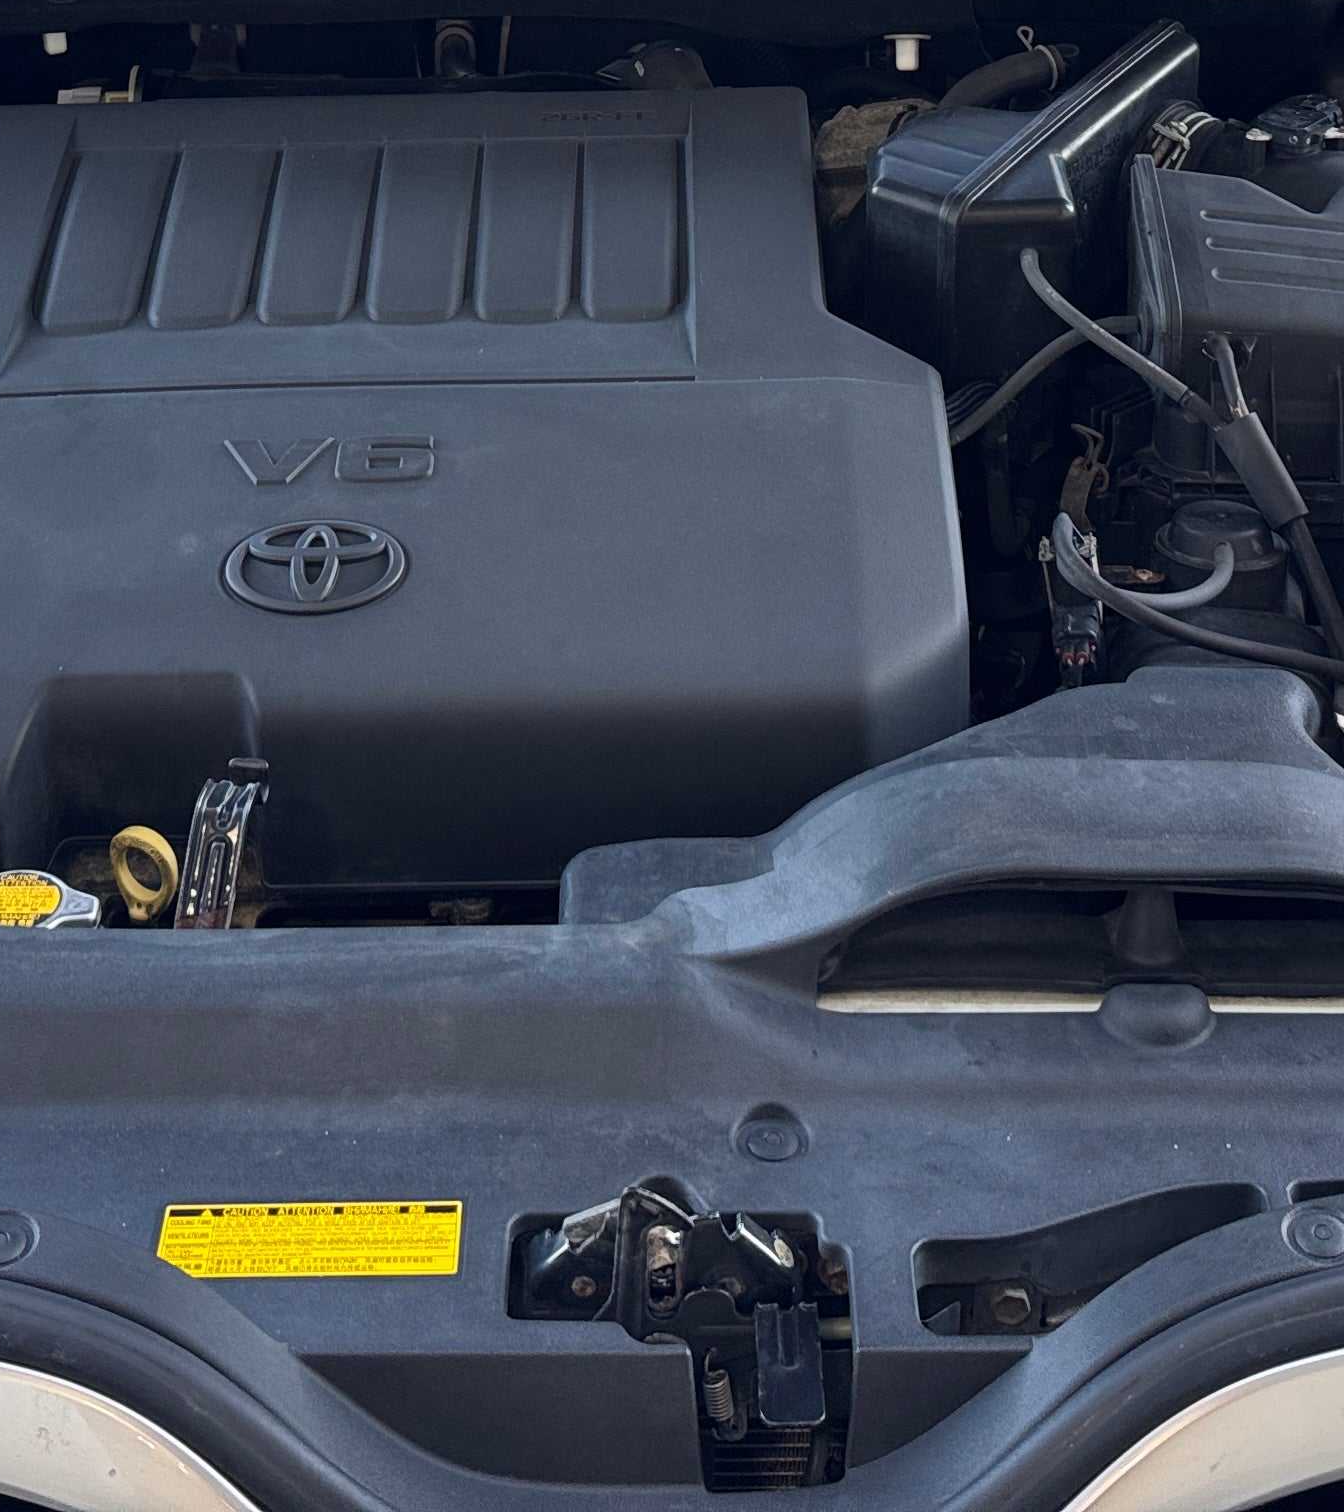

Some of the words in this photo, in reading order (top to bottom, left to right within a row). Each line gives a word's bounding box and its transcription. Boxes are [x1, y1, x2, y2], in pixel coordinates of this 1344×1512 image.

[223, 433, 436, 486] V6
[222, 1207, 269, 1216] CAUTION
[277, 1206, 334, 1216] ATTENTION
